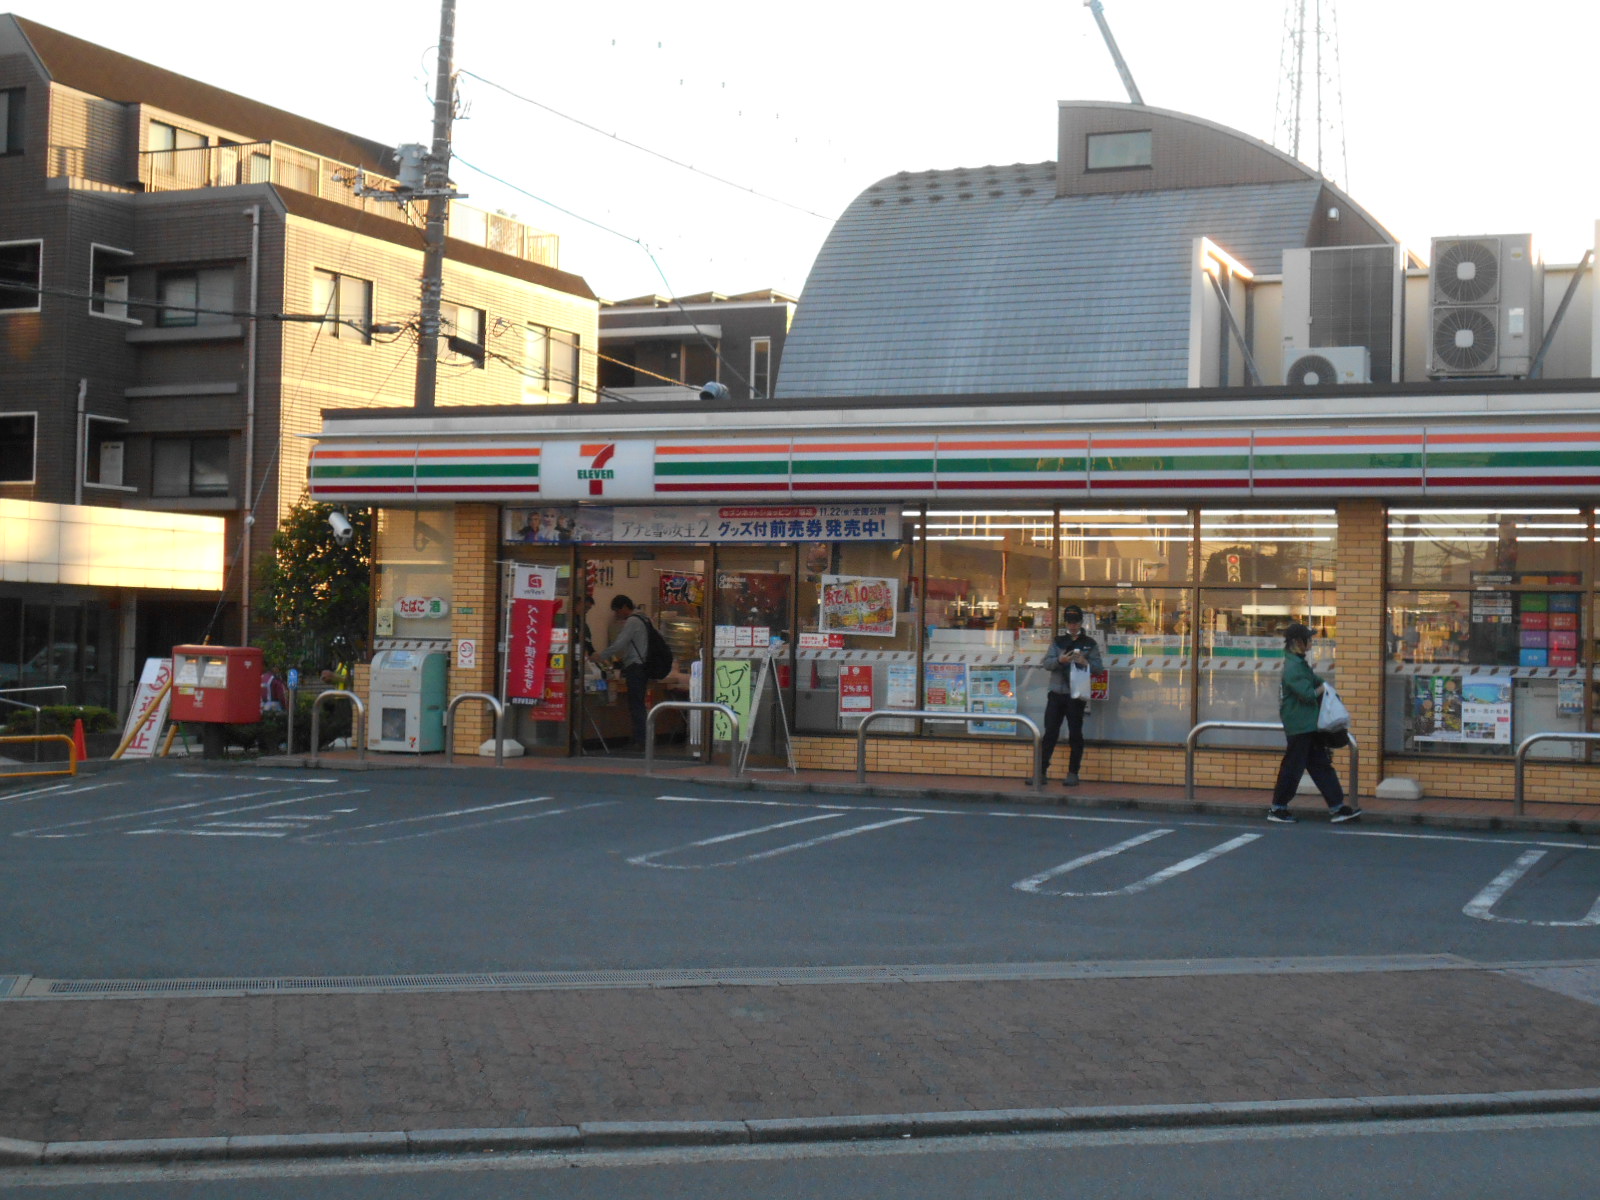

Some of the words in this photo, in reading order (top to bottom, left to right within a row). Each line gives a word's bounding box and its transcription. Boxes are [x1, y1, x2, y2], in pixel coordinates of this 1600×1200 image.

[577, 469, 614, 480] ELEVEN
[580, 444, 615, 495] 7
[401, 600, 425, 613] たばこ
[430, 600, 441, 613] 酒
